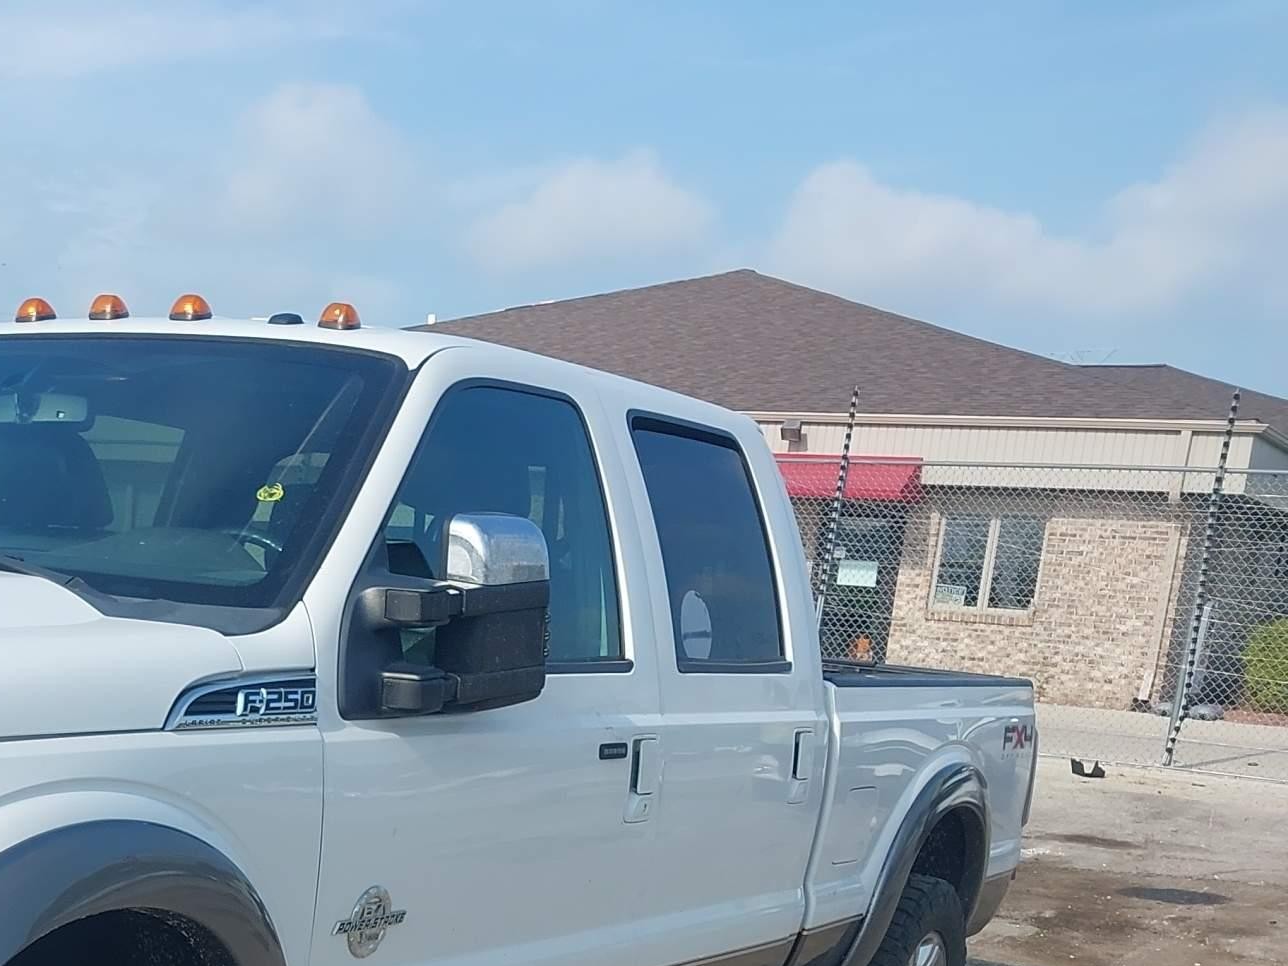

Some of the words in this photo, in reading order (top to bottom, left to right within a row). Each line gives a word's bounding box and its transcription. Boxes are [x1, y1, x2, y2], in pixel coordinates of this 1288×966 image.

[1002, 725, 1034, 751] FX4
[337, 917, 372, 933] POWER
[371, 911, 407, 929] STROKE
